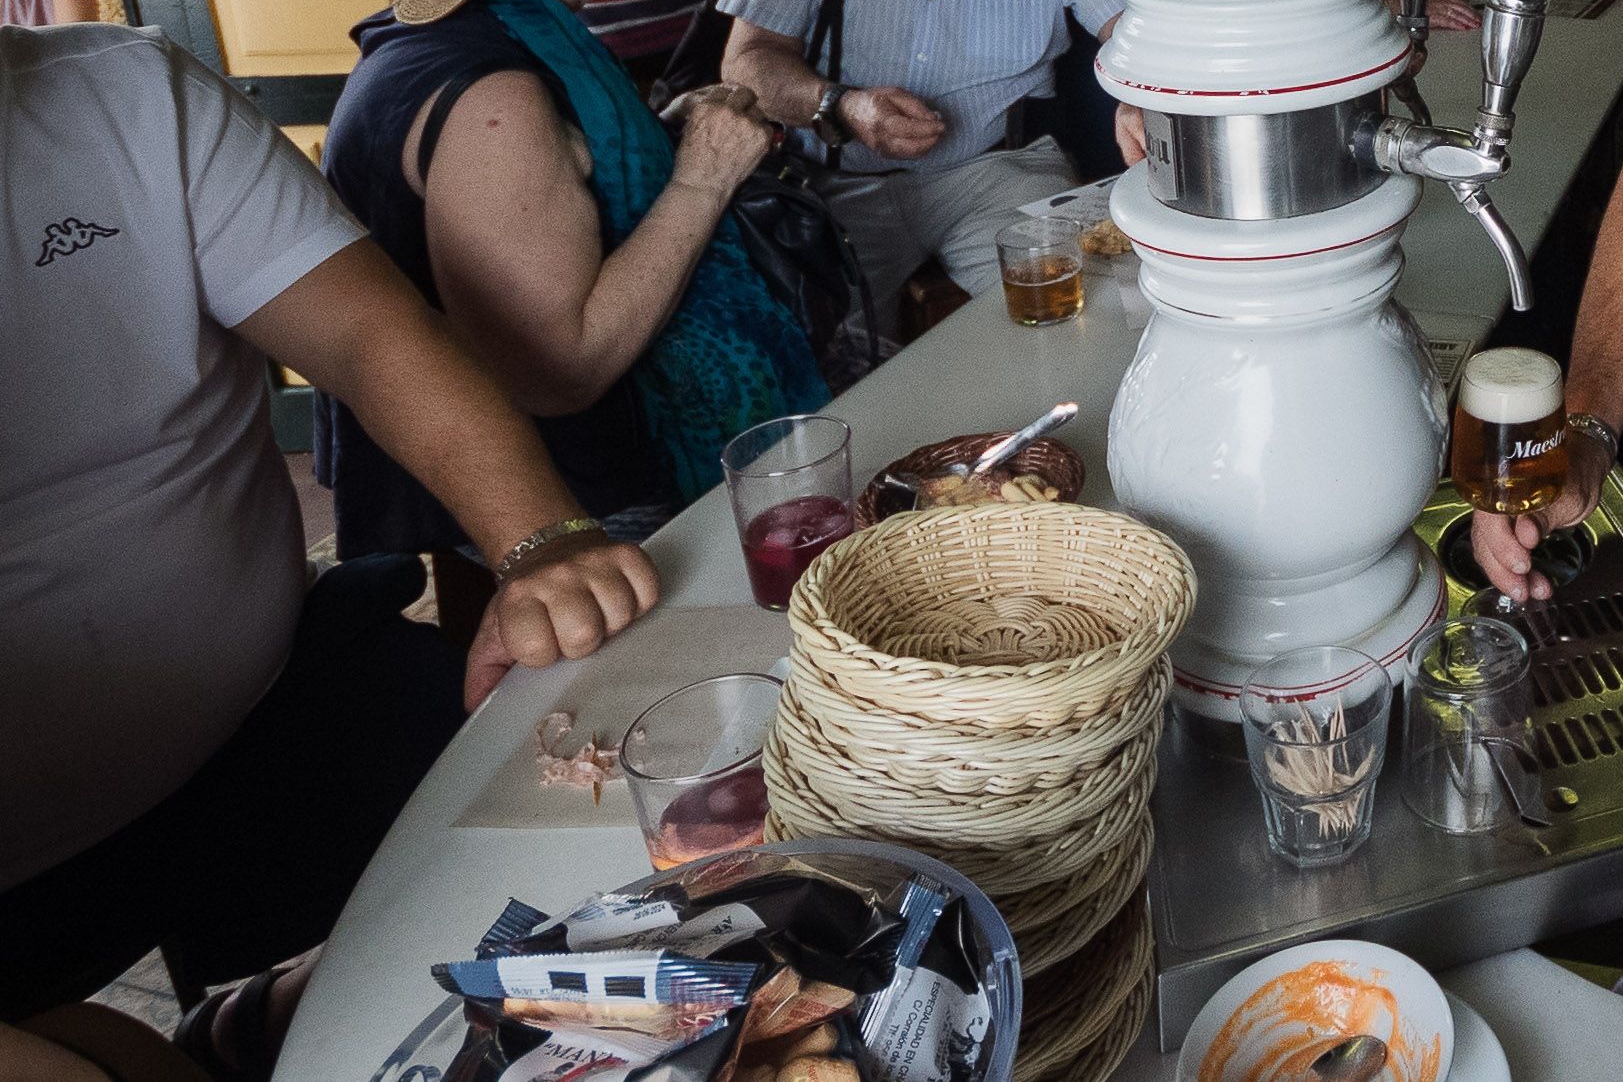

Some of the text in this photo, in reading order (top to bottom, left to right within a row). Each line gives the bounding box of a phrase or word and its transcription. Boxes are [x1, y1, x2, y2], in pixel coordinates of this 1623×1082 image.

[913, 999, 923, 1012] C/
[910, 981, 941, 1049] ESPECIALIDAD
[896, 1012, 918, 1050] Corralón
[890, 1050, 900, 1064] de
[903, 1049, 916, 1065] EN
